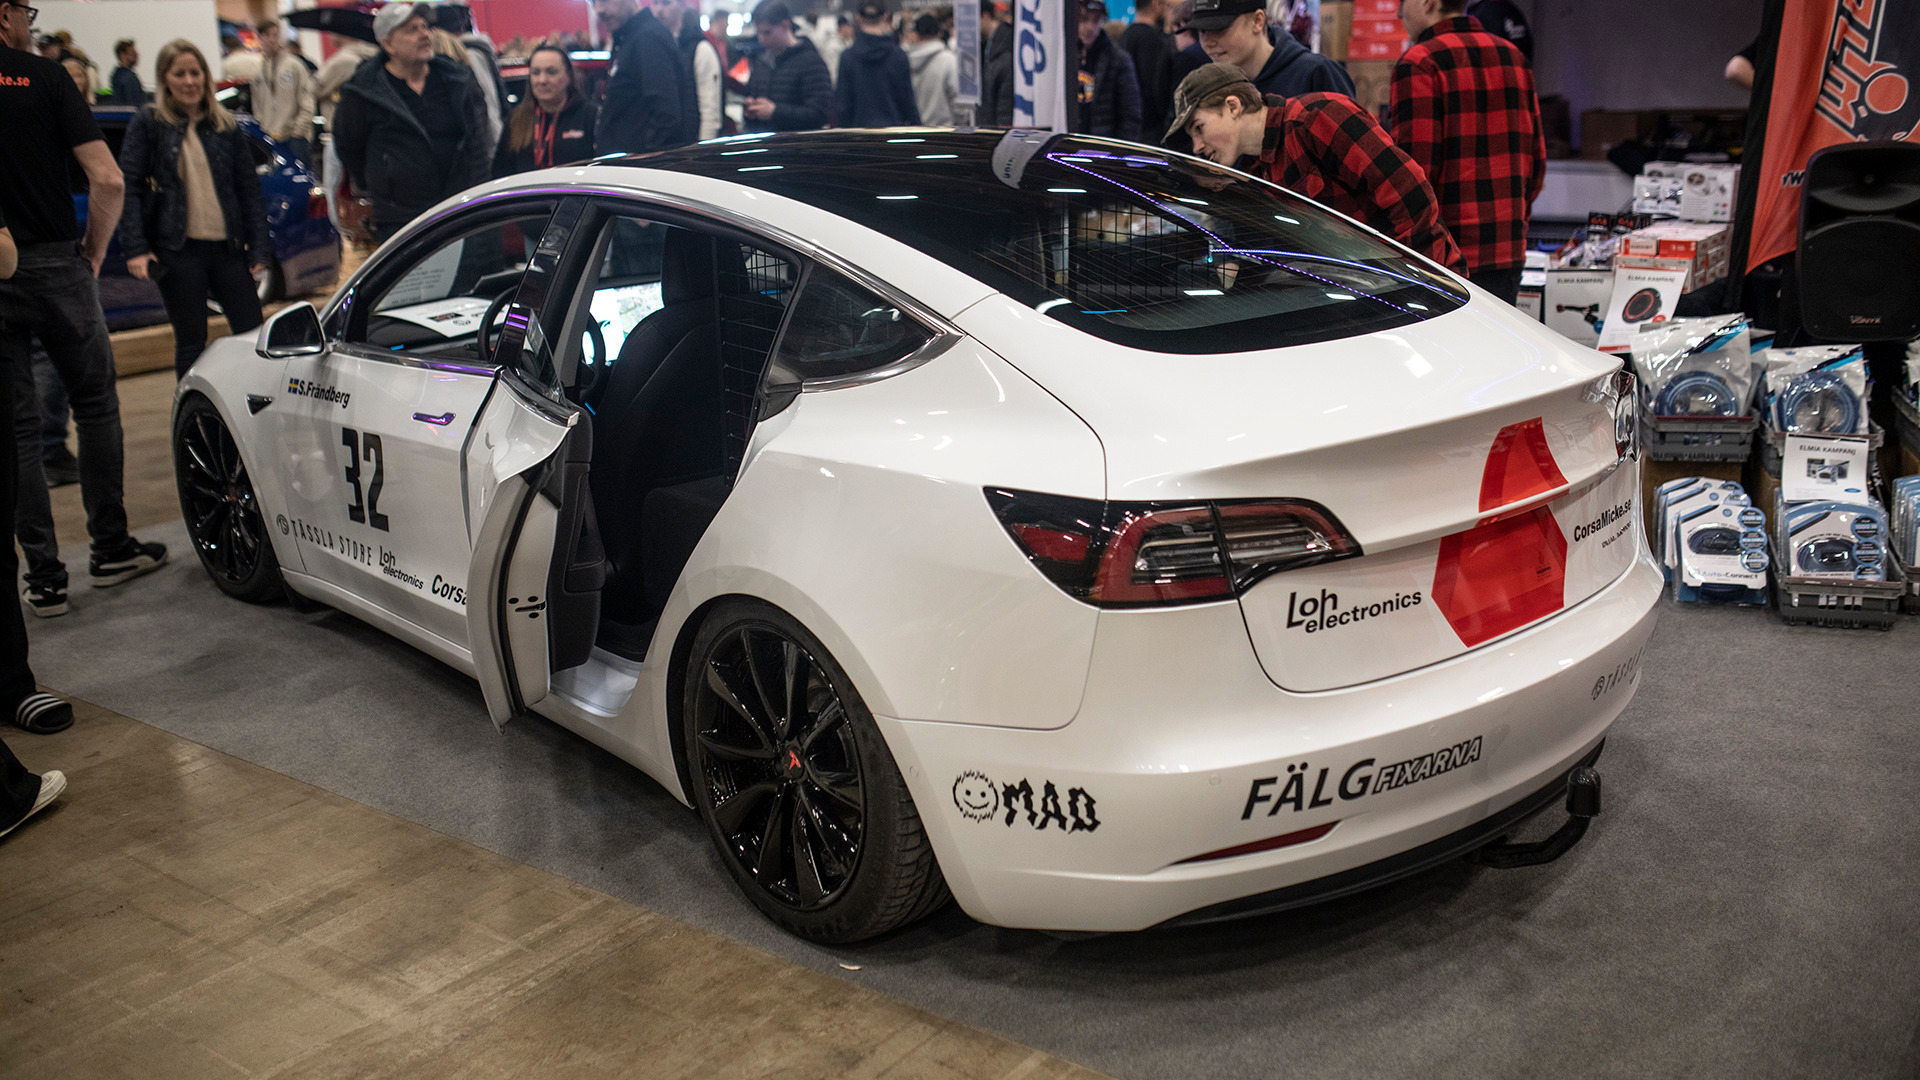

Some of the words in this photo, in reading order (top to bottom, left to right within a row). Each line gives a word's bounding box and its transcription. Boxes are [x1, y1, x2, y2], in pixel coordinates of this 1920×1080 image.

[298, 377, 350, 409] S.Frändberg
[1799, 444, 1822, 452] ELMIA
[1823, 446, 1857, 456] KAMPANJ
[341, 426, 390, 533] 32
[1573, 499, 1632, 542] CorsaMicke.se
[338, 537, 373, 567] STORE
[378, 545, 396, 572] Loh
[383, 563, 424, 590] electronics
[1286, 588, 1338, 630] Loh
[1305, 590, 1422, 633] electronics
[1241, 758, 1376, 821] FÄLG
[1371, 735, 1483, 795] FIXARNA
[1002, 777, 1101, 835] MAD
